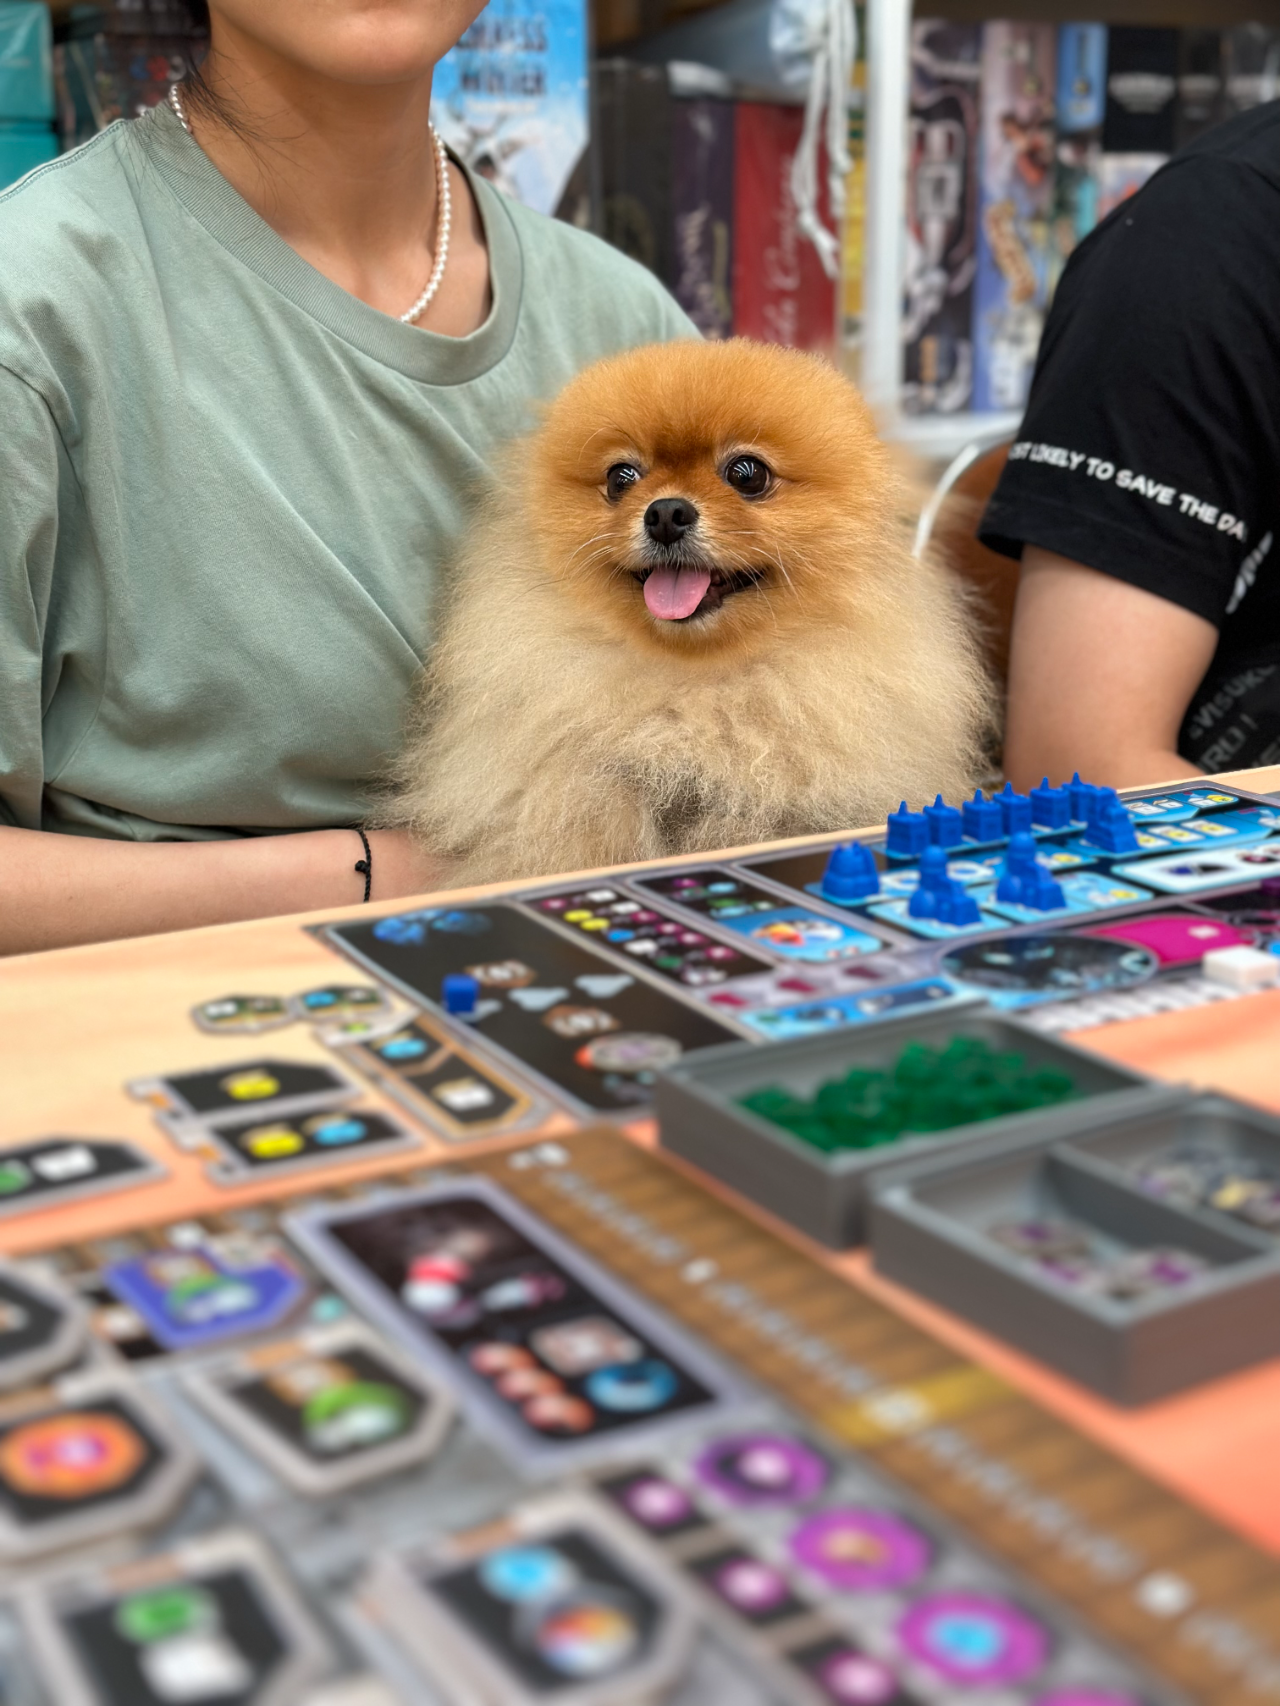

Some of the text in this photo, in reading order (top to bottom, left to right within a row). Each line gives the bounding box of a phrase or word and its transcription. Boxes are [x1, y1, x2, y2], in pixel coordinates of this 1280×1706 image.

[1029, 443, 1086, 471] LIKELY
[1086, 456, 1115, 480] TO
[1115, 469, 1176, 506] SAVE
[1178, 493, 1220, 525] THE
[1216, 512, 1248, 542] DA
